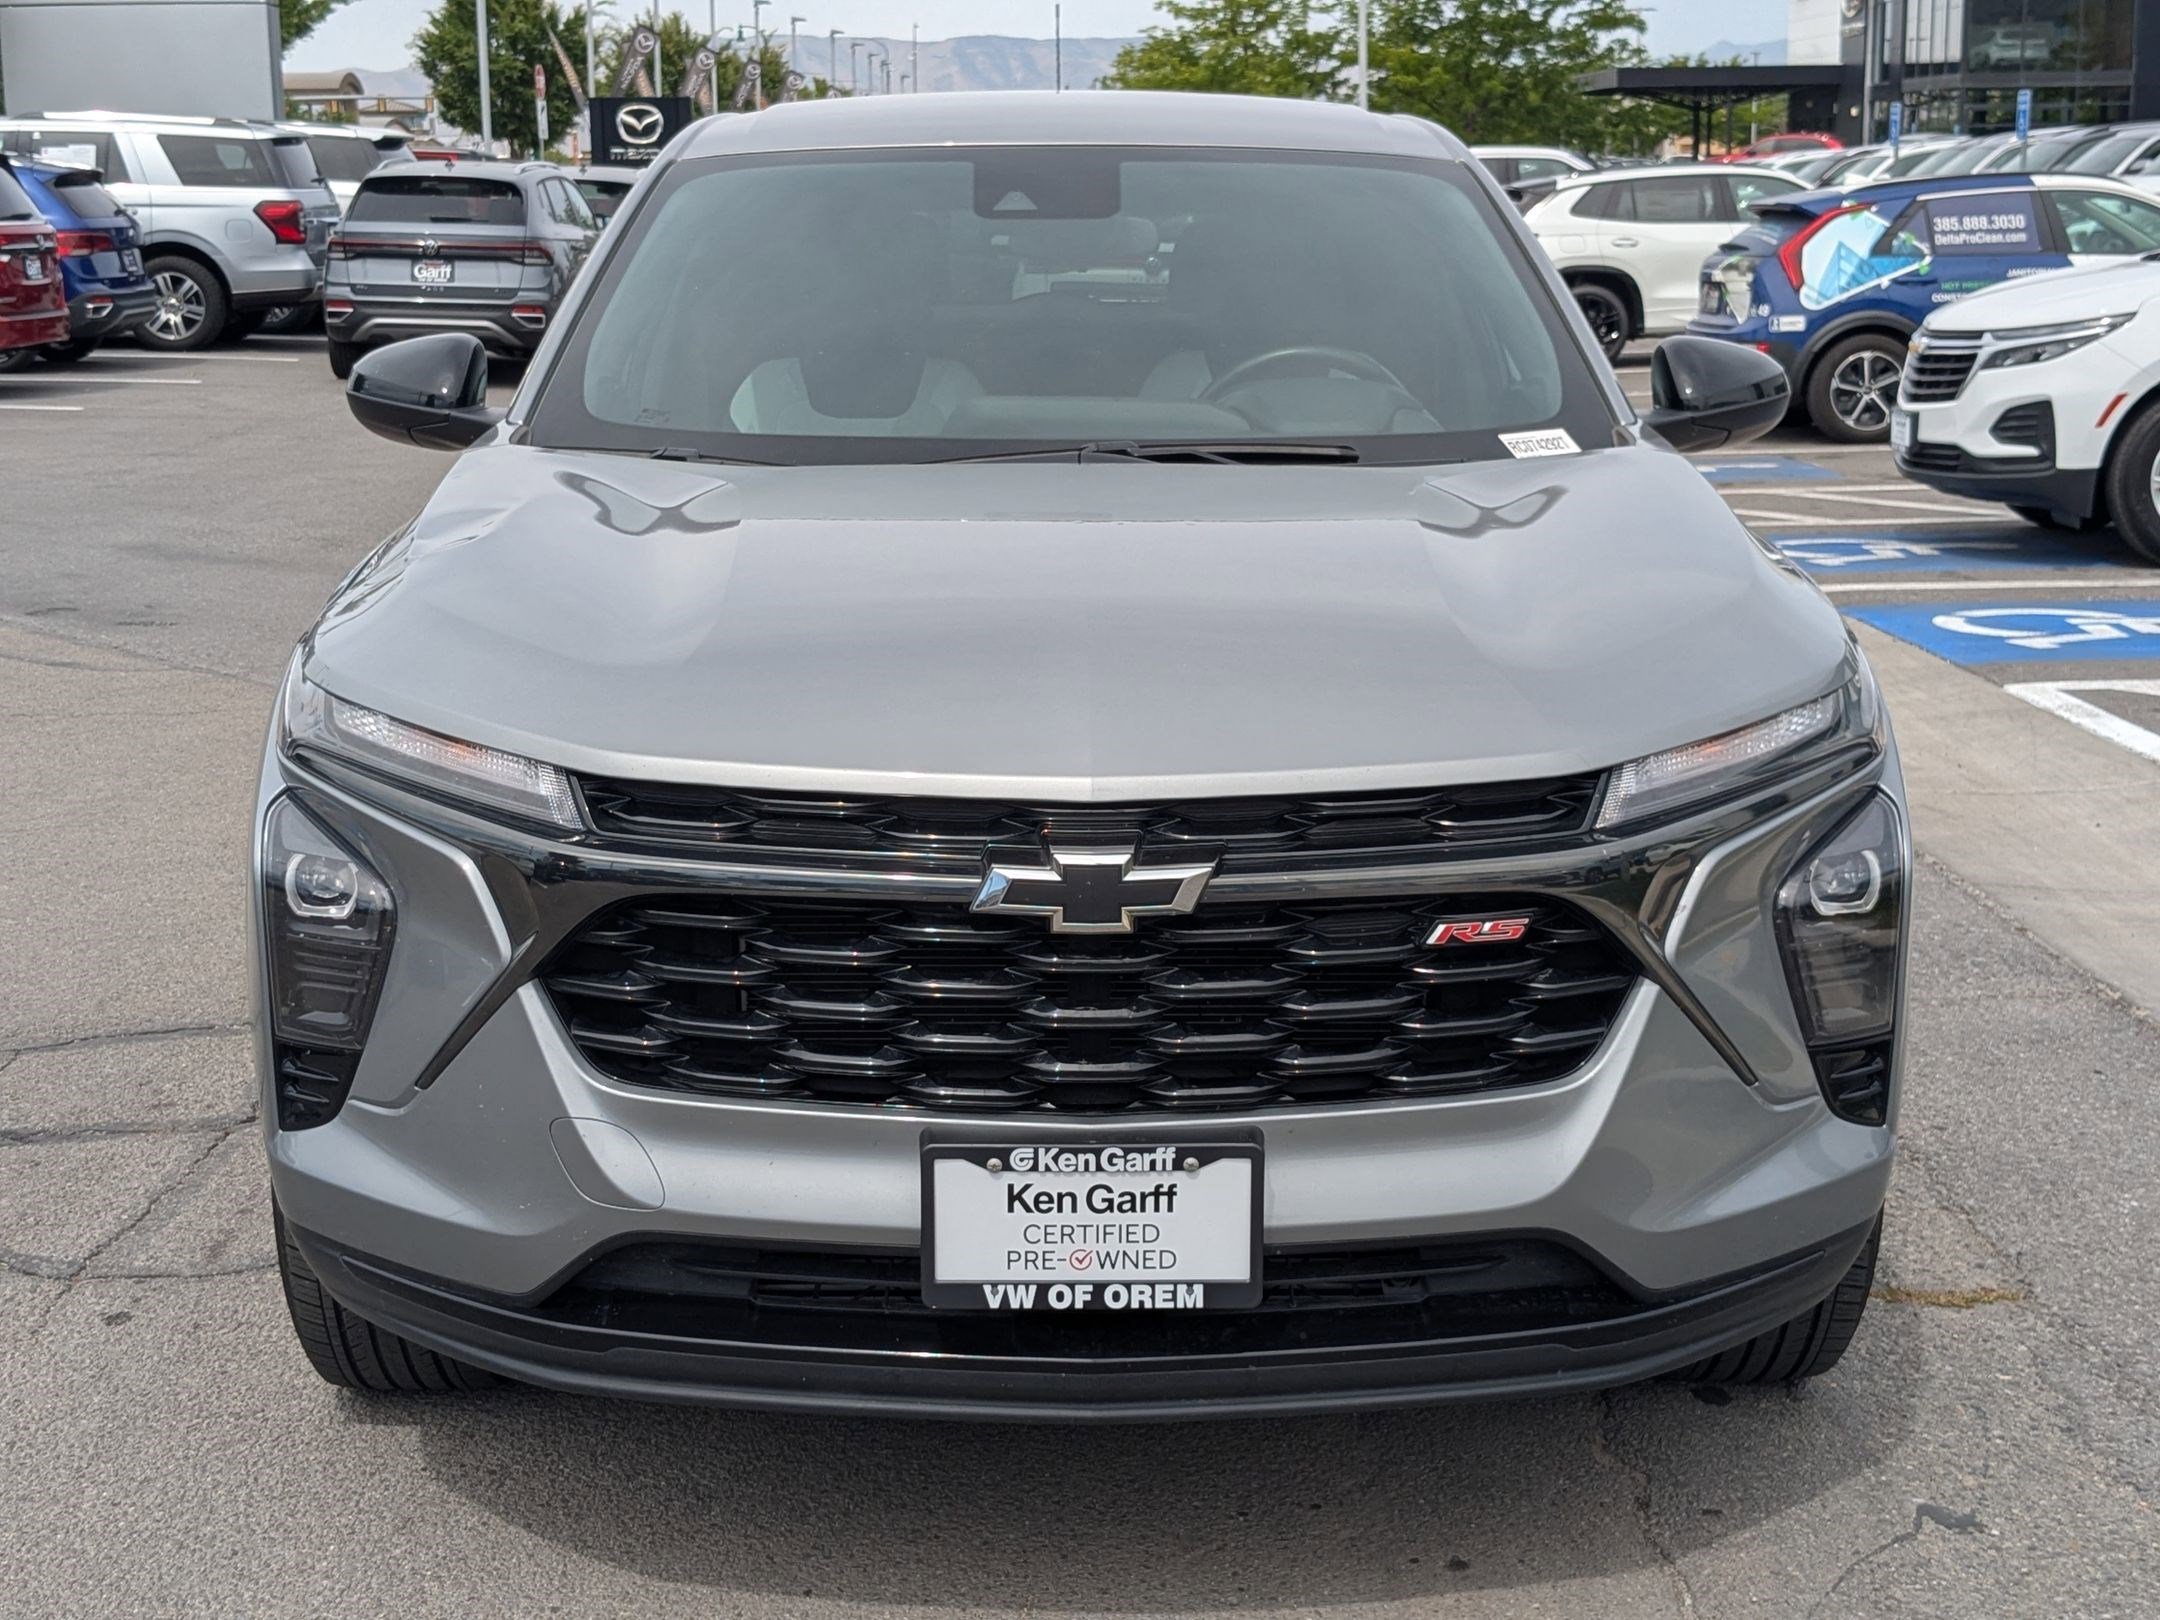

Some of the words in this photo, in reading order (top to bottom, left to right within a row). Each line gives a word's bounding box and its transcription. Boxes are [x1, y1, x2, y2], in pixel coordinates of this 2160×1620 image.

[1933, 214, 2026, 232] 385.888.3030
[1934, 232, 2027, 246] DeltaProClean.com
[413, 263, 452, 279] Garff
[1426, 918, 1530, 945] RS
[1038, 1147, 1097, 1173] Ken
[1100, 1147, 1177, 1173] Garff
[1007, 1183, 1078, 1214] Ken
[1086, 1183, 1178, 1214] Garff
[1023, 1224, 1161, 1245] CERTIFIED
[983, 1284, 1037, 1309] VW
[1048, 1284, 1094, 1309] OF
[1103, 1284, 1204, 1309] OREM
